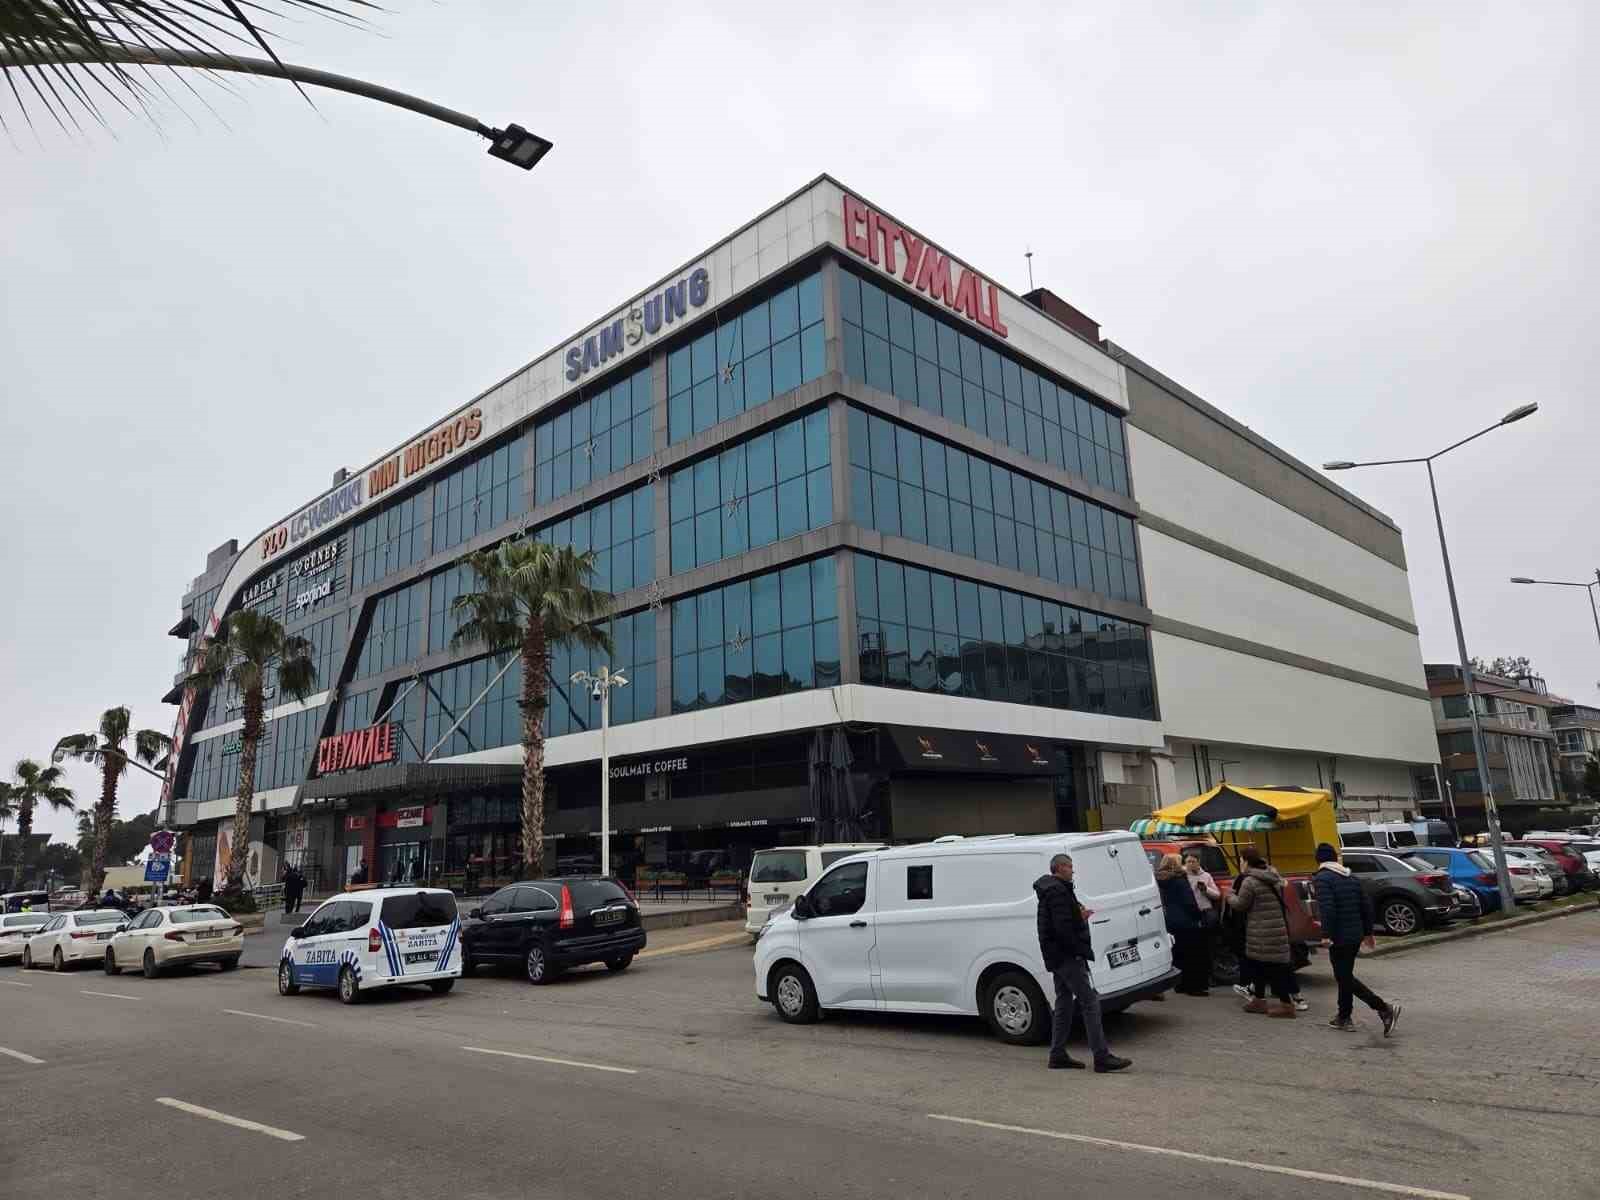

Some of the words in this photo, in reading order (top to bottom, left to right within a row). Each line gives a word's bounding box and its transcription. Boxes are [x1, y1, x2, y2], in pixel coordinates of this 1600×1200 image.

[843, 192, 1008, 338] CITYMALL
[565, 267, 709, 382] SAMSUNG
[403, 407, 482, 478] MIGROS
[261, 525, 288, 560] FLO
[317, 723, 393, 774] CITYMALL
[609, 762, 652, 778] SOULMATE
[654, 757, 688, 773] COFFEE
[305, 949, 336, 964] ZABITA
